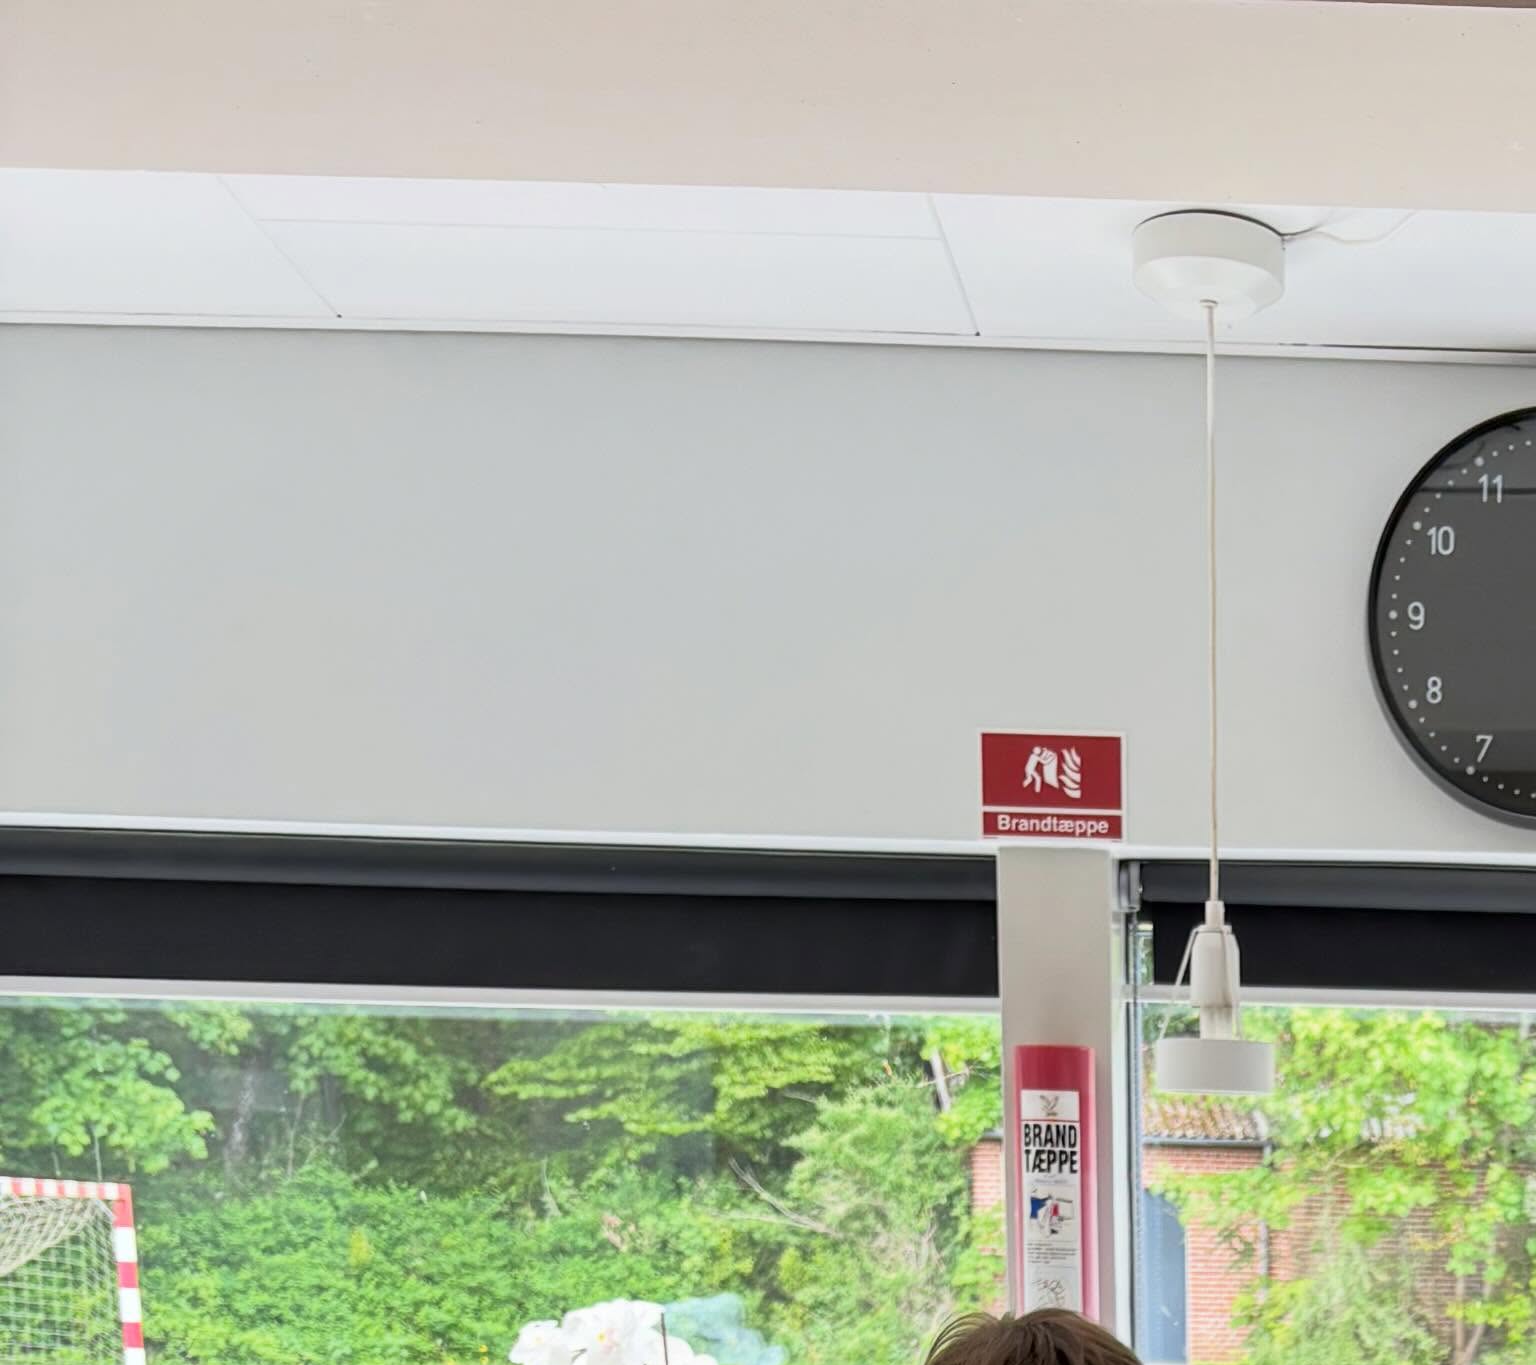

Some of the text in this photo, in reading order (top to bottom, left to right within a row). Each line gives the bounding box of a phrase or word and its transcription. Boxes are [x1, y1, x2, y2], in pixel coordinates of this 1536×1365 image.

[1478, 474, 1503, 503] 11
[1427, 525, 1456, 555] 10
[1407, 601, 1426, 630] 9
[1426, 676, 1444, 704] 8
[1475, 734, 1494, 763] 7
[996, 814, 1109, 836] Brandtæppe
[1024, 1123, 1078, 1149] BRAND
[1025, 1149, 1079, 1174] TÆPPE
